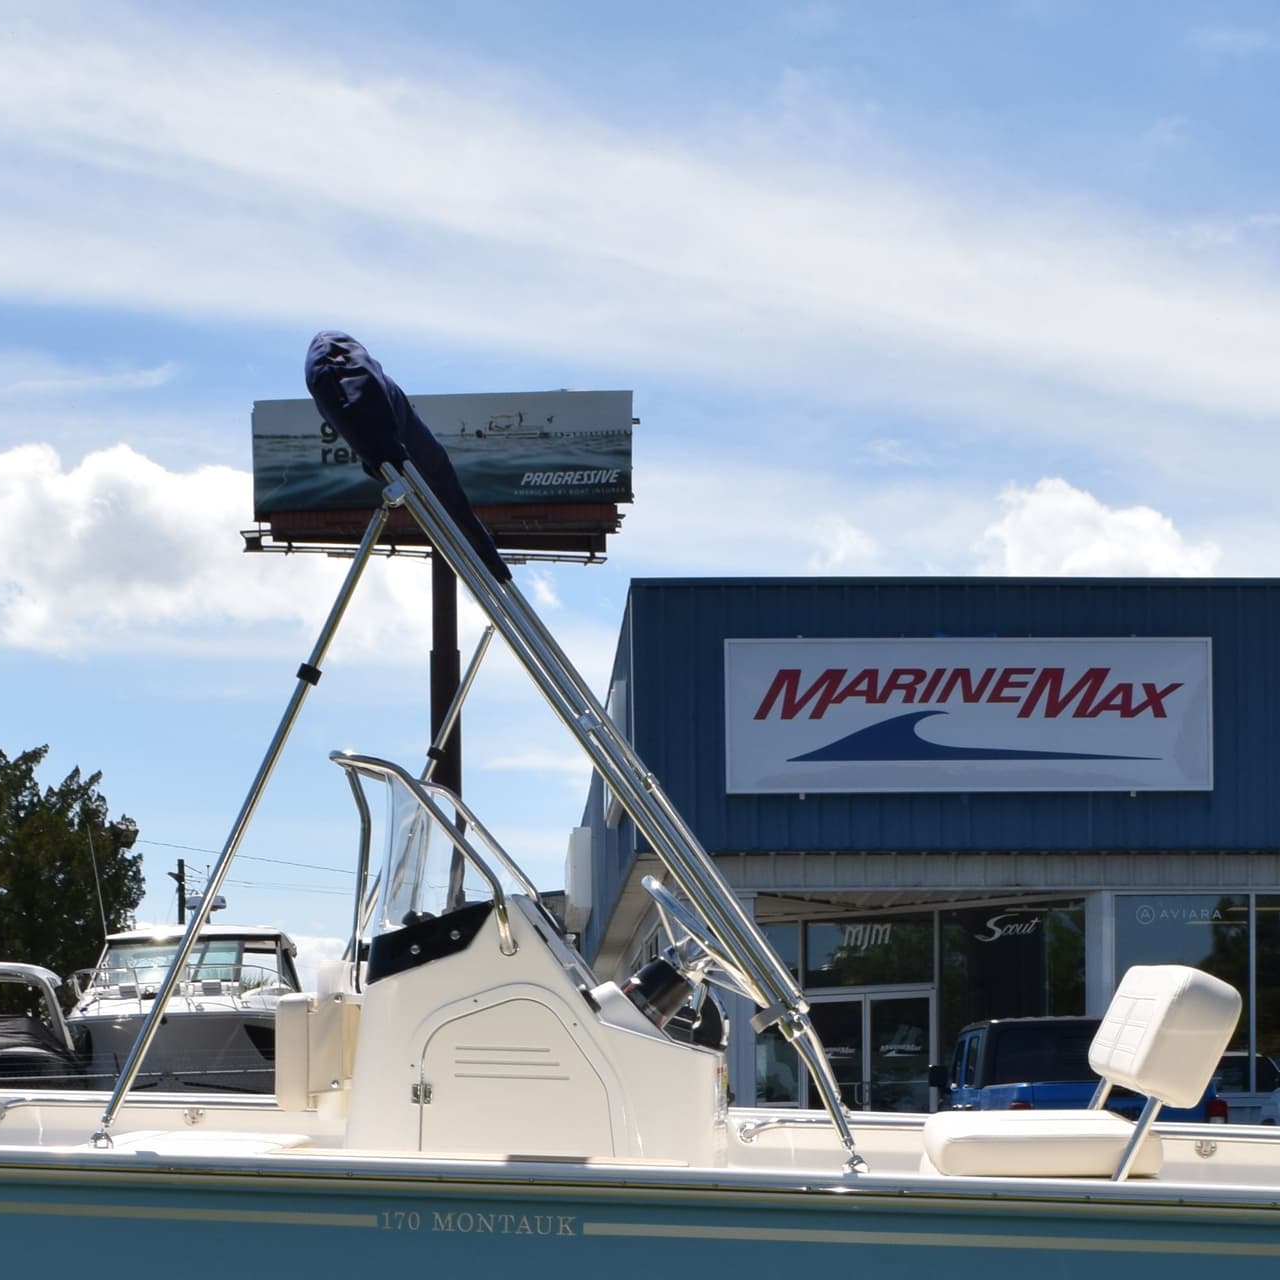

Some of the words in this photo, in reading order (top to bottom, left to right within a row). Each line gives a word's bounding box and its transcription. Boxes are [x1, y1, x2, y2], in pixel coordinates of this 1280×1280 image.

[520, 469, 620, 486] PROGRESSIVE
[1159, 908, 1222, 920] AVIARA
[973, 913, 1042, 942] Scout
[381, 1211, 420, 1231] 170
[431, 1212, 577, 1236] MONTAUK
